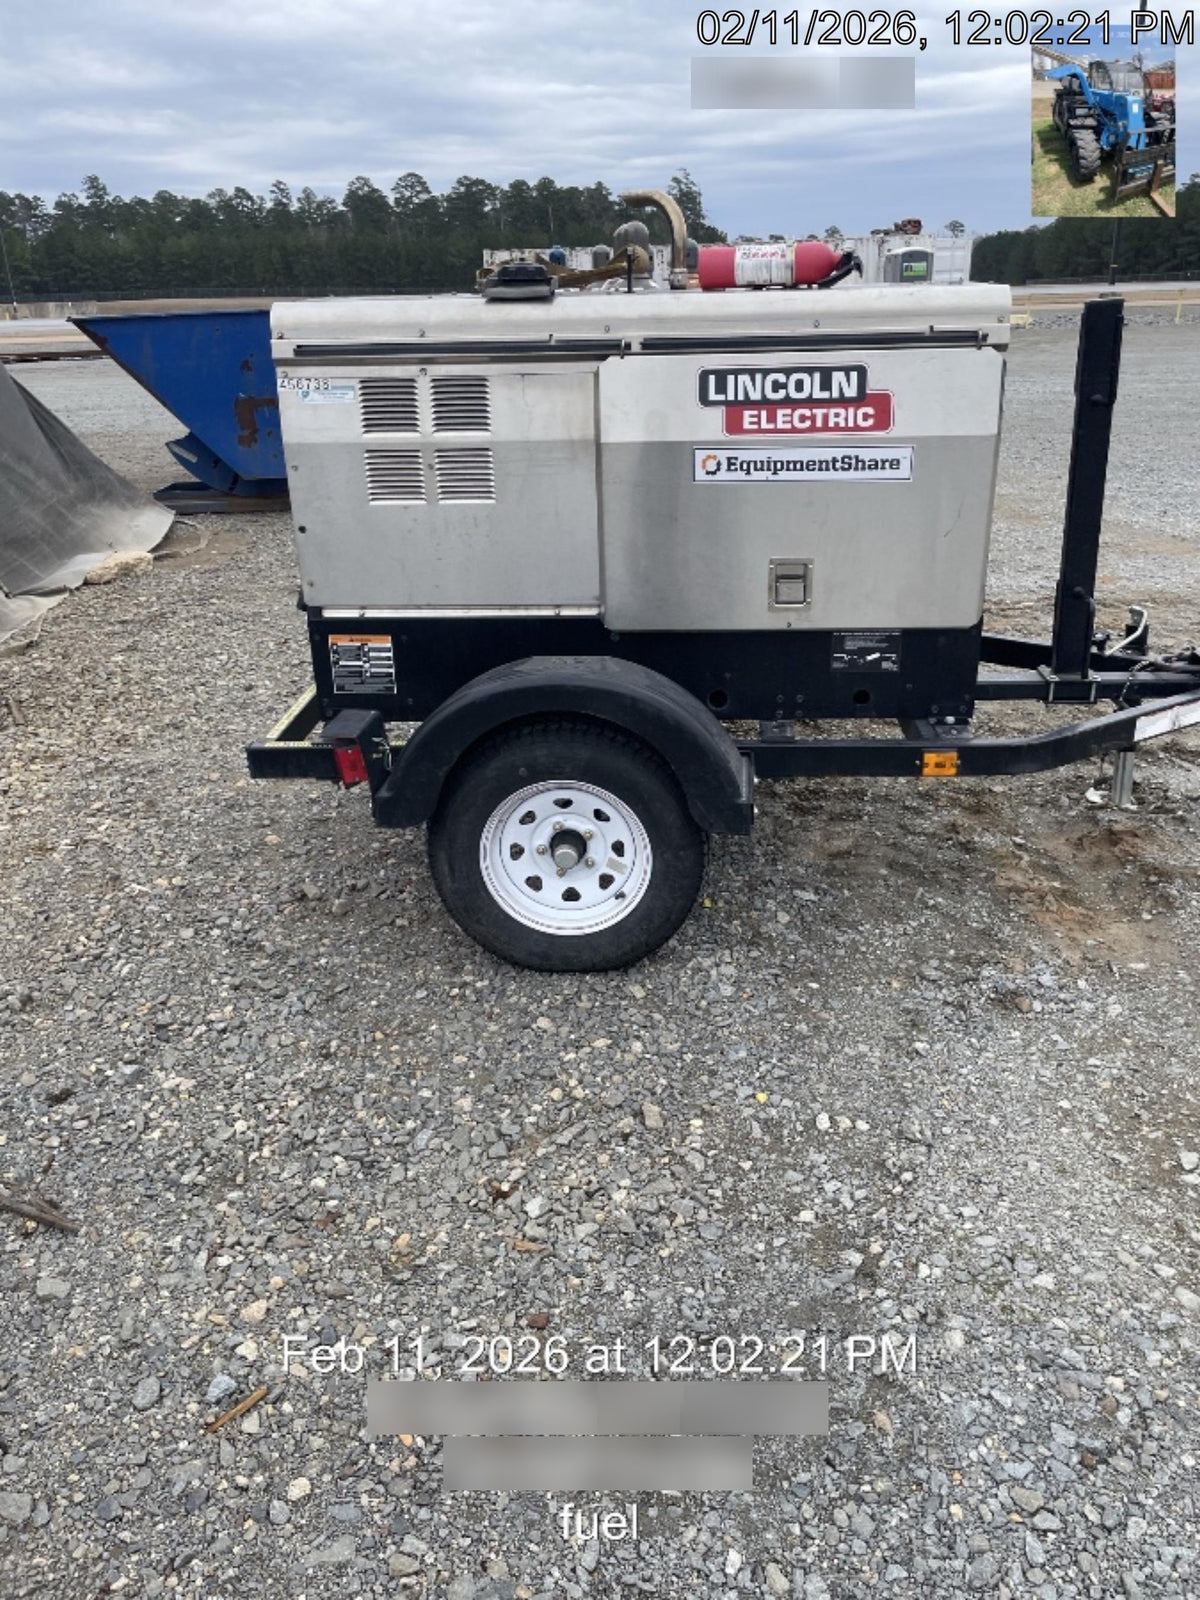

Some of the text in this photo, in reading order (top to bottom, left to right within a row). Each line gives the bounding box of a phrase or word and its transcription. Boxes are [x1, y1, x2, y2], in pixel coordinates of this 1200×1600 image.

[707, 370, 859, 401] LINCOLN
[742, 406, 876, 430] ELECTRIC
[725, 455, 901, 475] EquipmentShare
